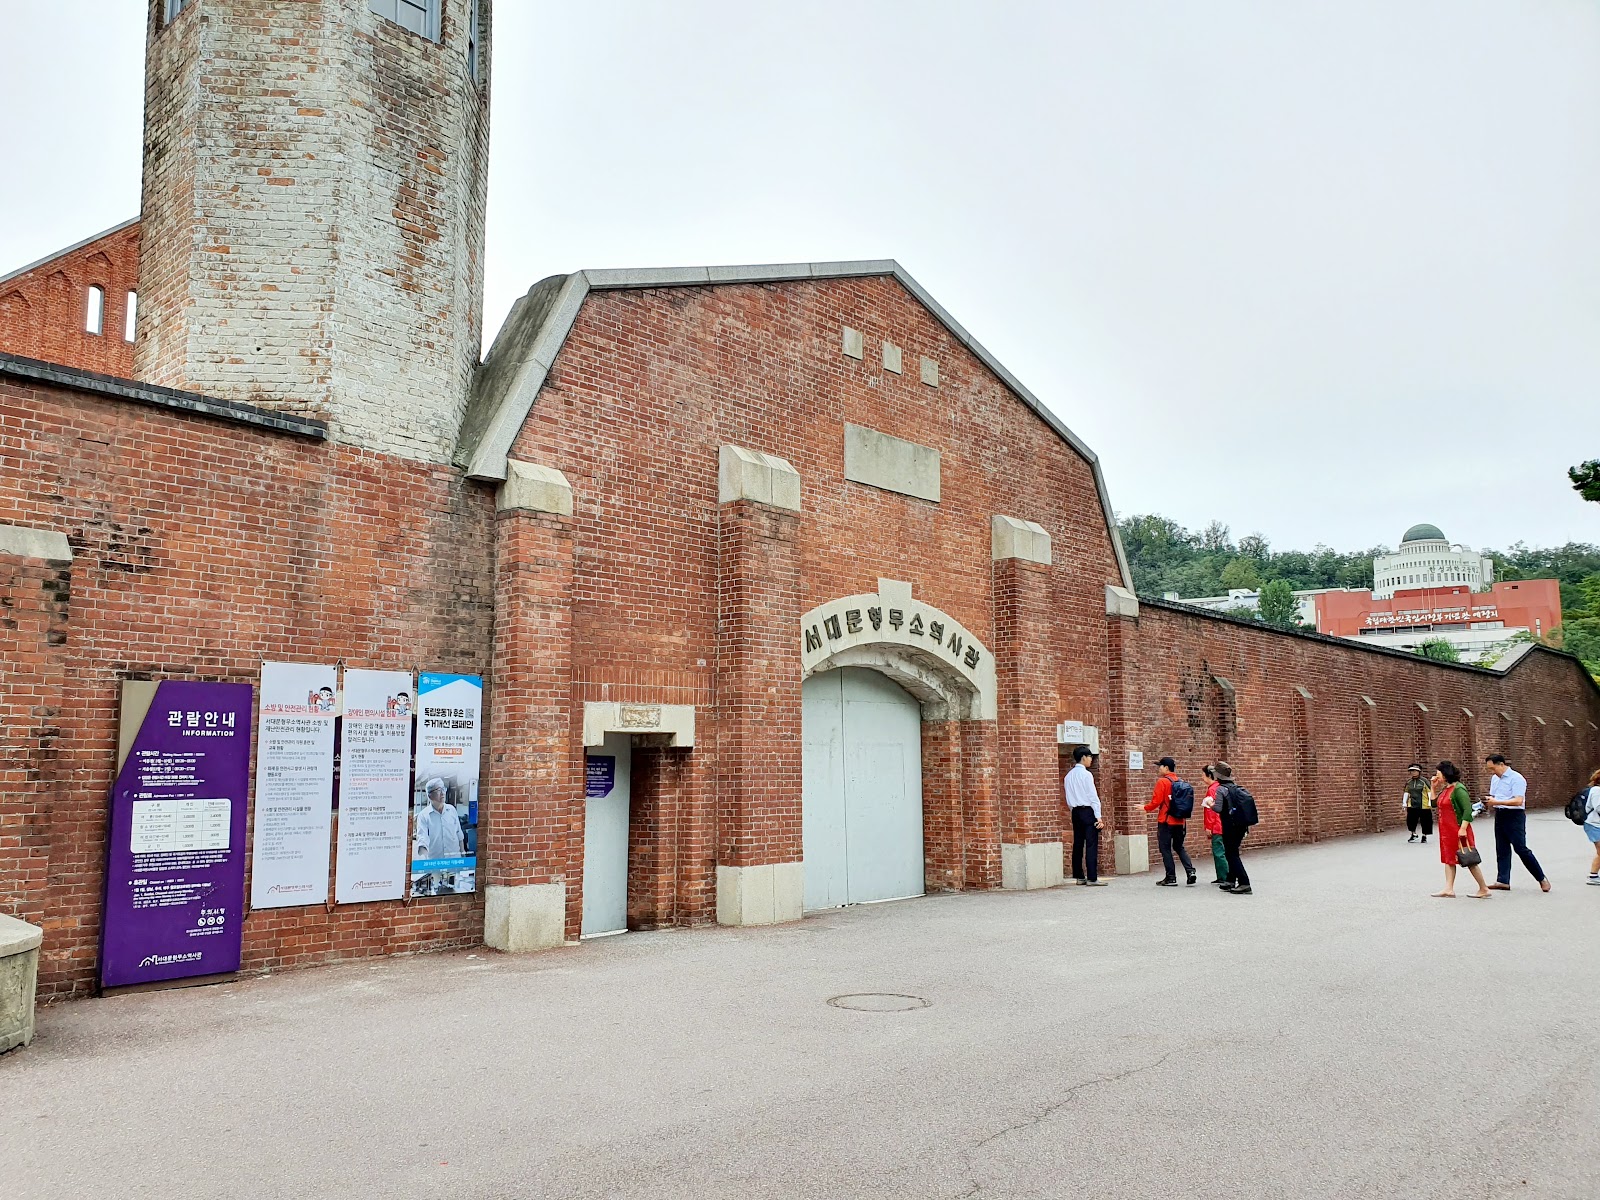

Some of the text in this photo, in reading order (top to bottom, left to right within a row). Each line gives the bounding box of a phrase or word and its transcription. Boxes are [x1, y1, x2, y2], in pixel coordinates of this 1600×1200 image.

[1473, 610, 1498, 619] 예정지
[805, 606, 980, 670] 서대문형무소역사관
[365, 709, 385, 717] 편의시설
[425, 708, 464, 718] 독립운동가 후손
[168, 711, 235, 728] 관람안내
[424, 719, 473, 729] 주거개선 캠페인
